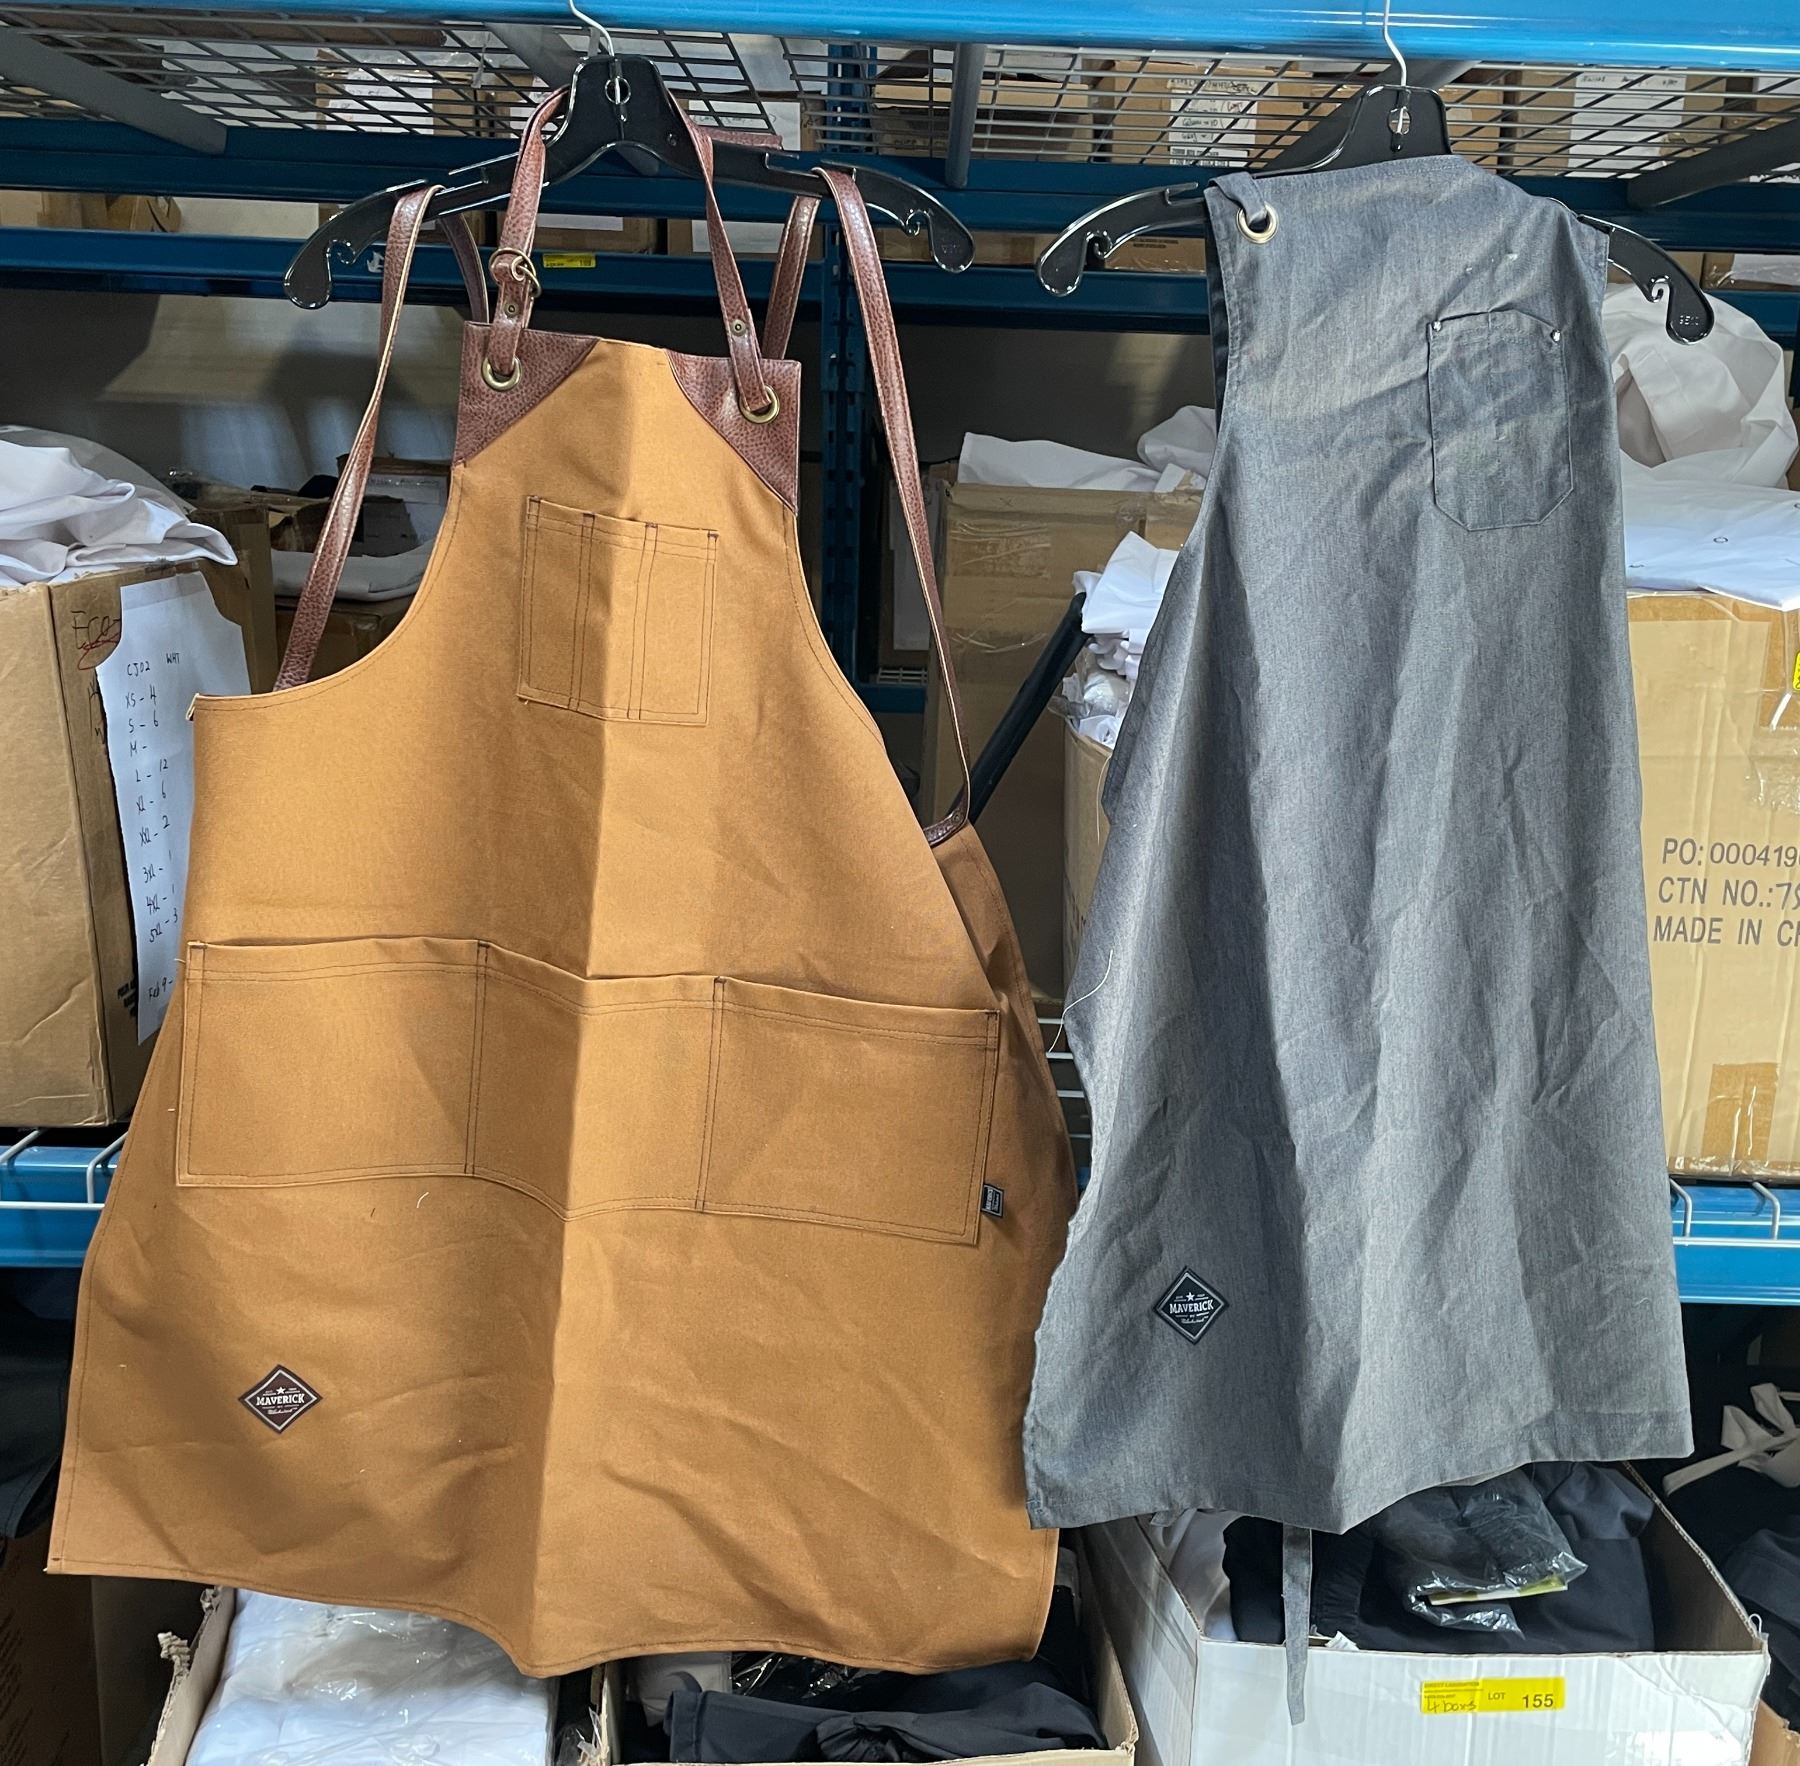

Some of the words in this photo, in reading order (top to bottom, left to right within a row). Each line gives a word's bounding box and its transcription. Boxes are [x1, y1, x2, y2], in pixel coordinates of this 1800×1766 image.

[166, 652, 180, 665] WHT
[125, 692, 136, 708] XS
[129, 718, 134, 733] S
[153, 710, 159, 727] 6
[130, 740, 138, 757] M
[135, 768, 141, 782] L
[159, 758, 169, 772] 12
[162, 815, 170, 829] 2
[1658, 876, 1707, 905] CTN
[1653, 915, 1723, 944] MADE
[1737, 918, 1762, 946] IN
[1169, 1299, 1214, 1314] MAVERICK
[256, 1393, 305, 1406] MAVERICK
[1487, 1692, 1506, 1700] LOT
[1522, 1694, 1554, 1709] 155
